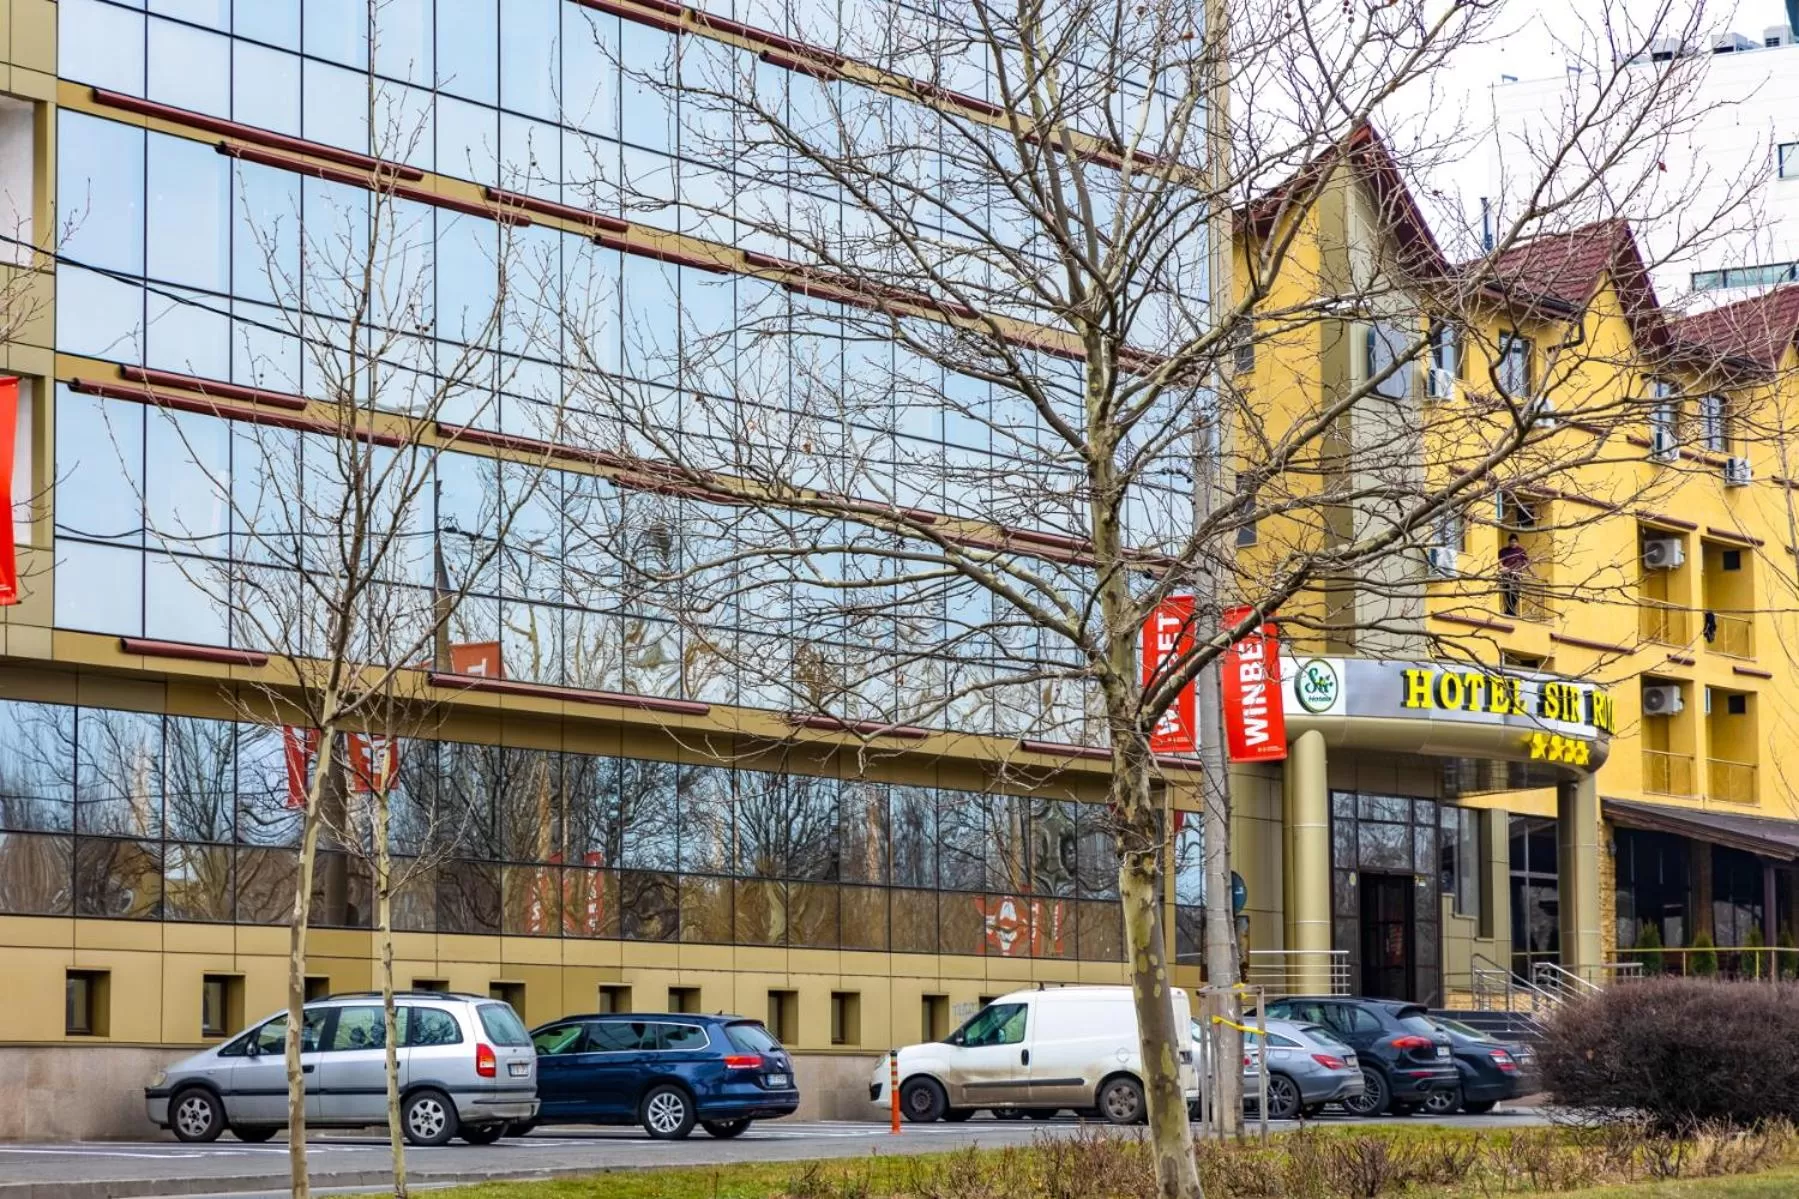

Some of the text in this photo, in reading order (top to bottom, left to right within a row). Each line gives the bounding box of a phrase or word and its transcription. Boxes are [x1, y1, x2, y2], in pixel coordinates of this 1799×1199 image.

[1238, 626, 1269, 747] WINBE
[1402, 668, 1527, 716] HOTEL
[1540, 681, 1581, 723] SIR
